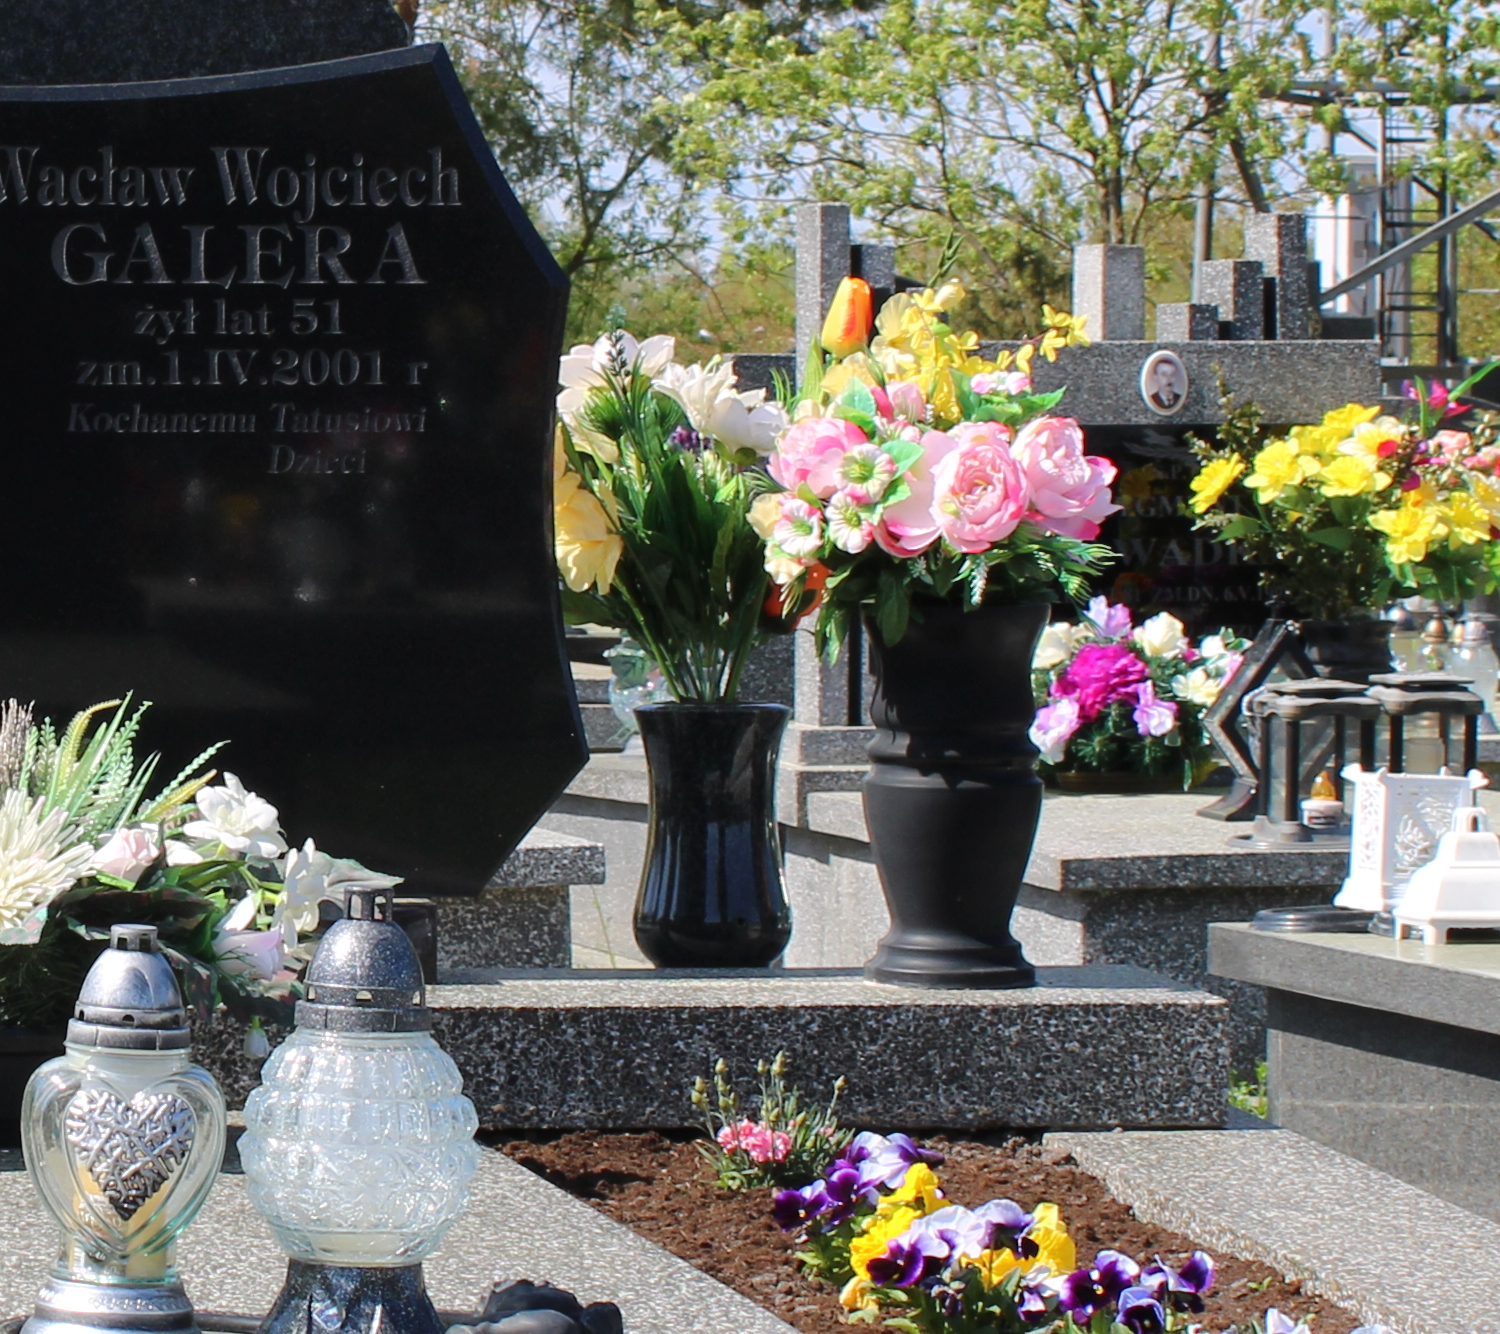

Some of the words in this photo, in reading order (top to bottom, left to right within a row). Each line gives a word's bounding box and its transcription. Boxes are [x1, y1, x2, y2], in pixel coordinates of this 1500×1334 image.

[211, 146, 463, 223] Wojciech
[50, 221, 428, 290] GALERA
[134, 297, 200, 345] żył
[214, 297, 276, 335] lat
[289, 297, 345, 335] 51
[407, 360, 428, 386] r
[66, 402, 257, 434] Kochanemu
[270, 402, 427, 434] Tatusiowi
[267, 444, 368, 475] Dzieci
